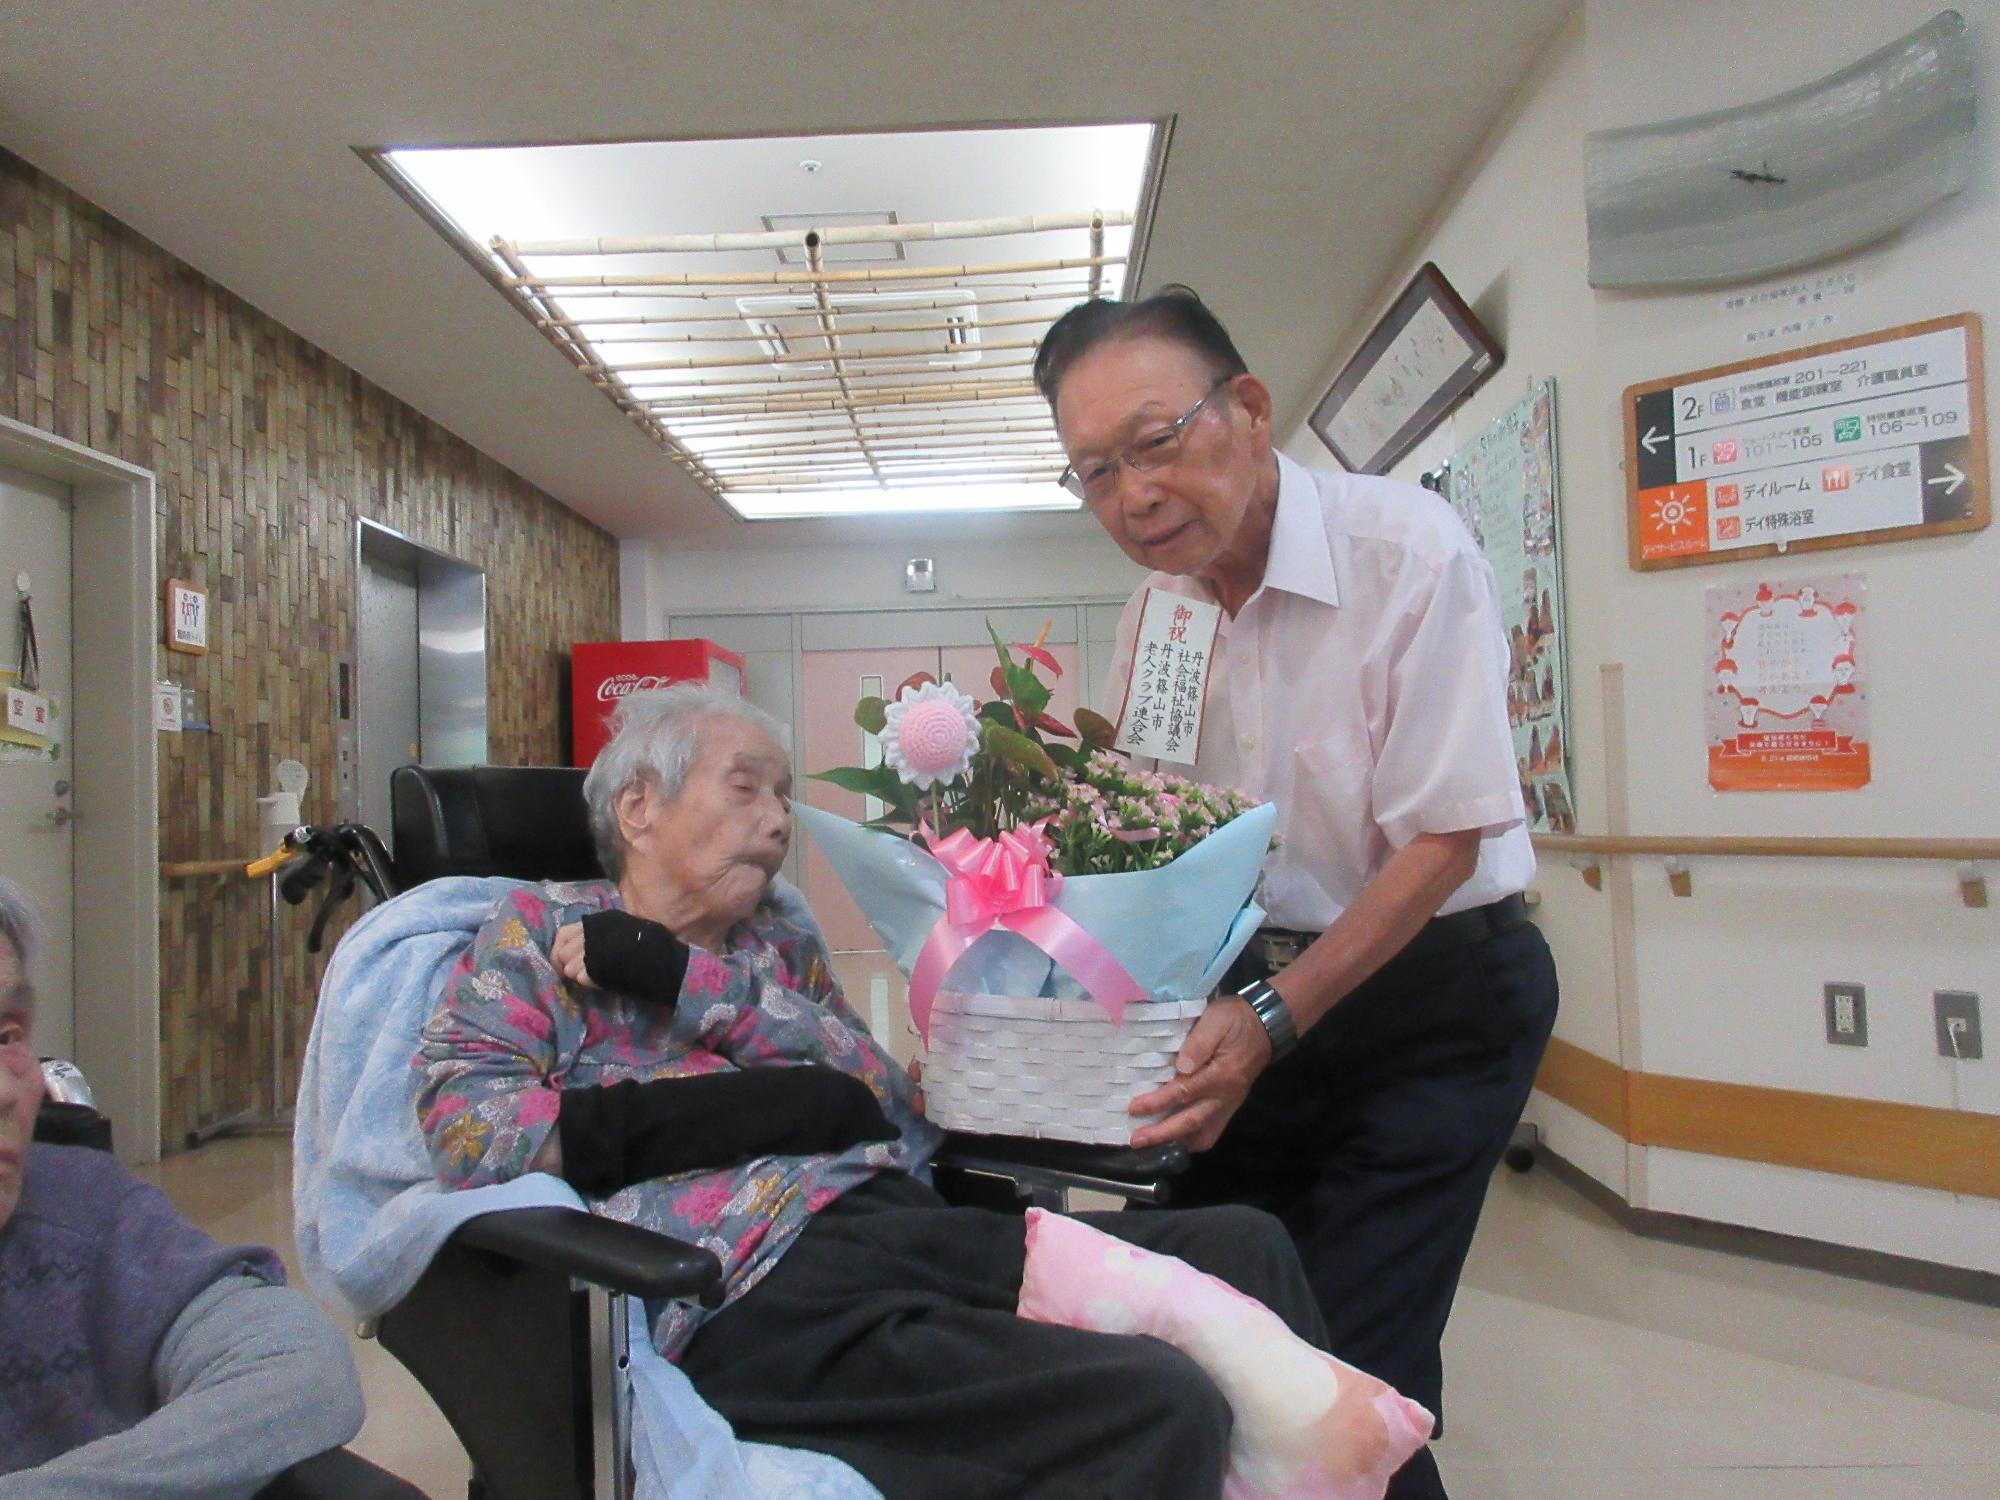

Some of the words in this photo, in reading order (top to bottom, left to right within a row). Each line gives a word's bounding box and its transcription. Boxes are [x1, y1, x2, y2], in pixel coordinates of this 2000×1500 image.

[1681, 396, 1705, 421] 2F
[1687, 446, 1707, 470] 1F
[1743, 476, 1812, 500] デイルーム
[1854, 461, 1912, 484] デイ食堂
[1167, 603, 1193, 645] 御祝
[1126, 640, 1159, 746] 老人クラブ連合会
[1151, 643, 1174, 731] 丹波篠山市
[1165, 648, 1191, 753] 社会福祉協議会
[1183, 649, 1204, 738] 丹波篠山市
